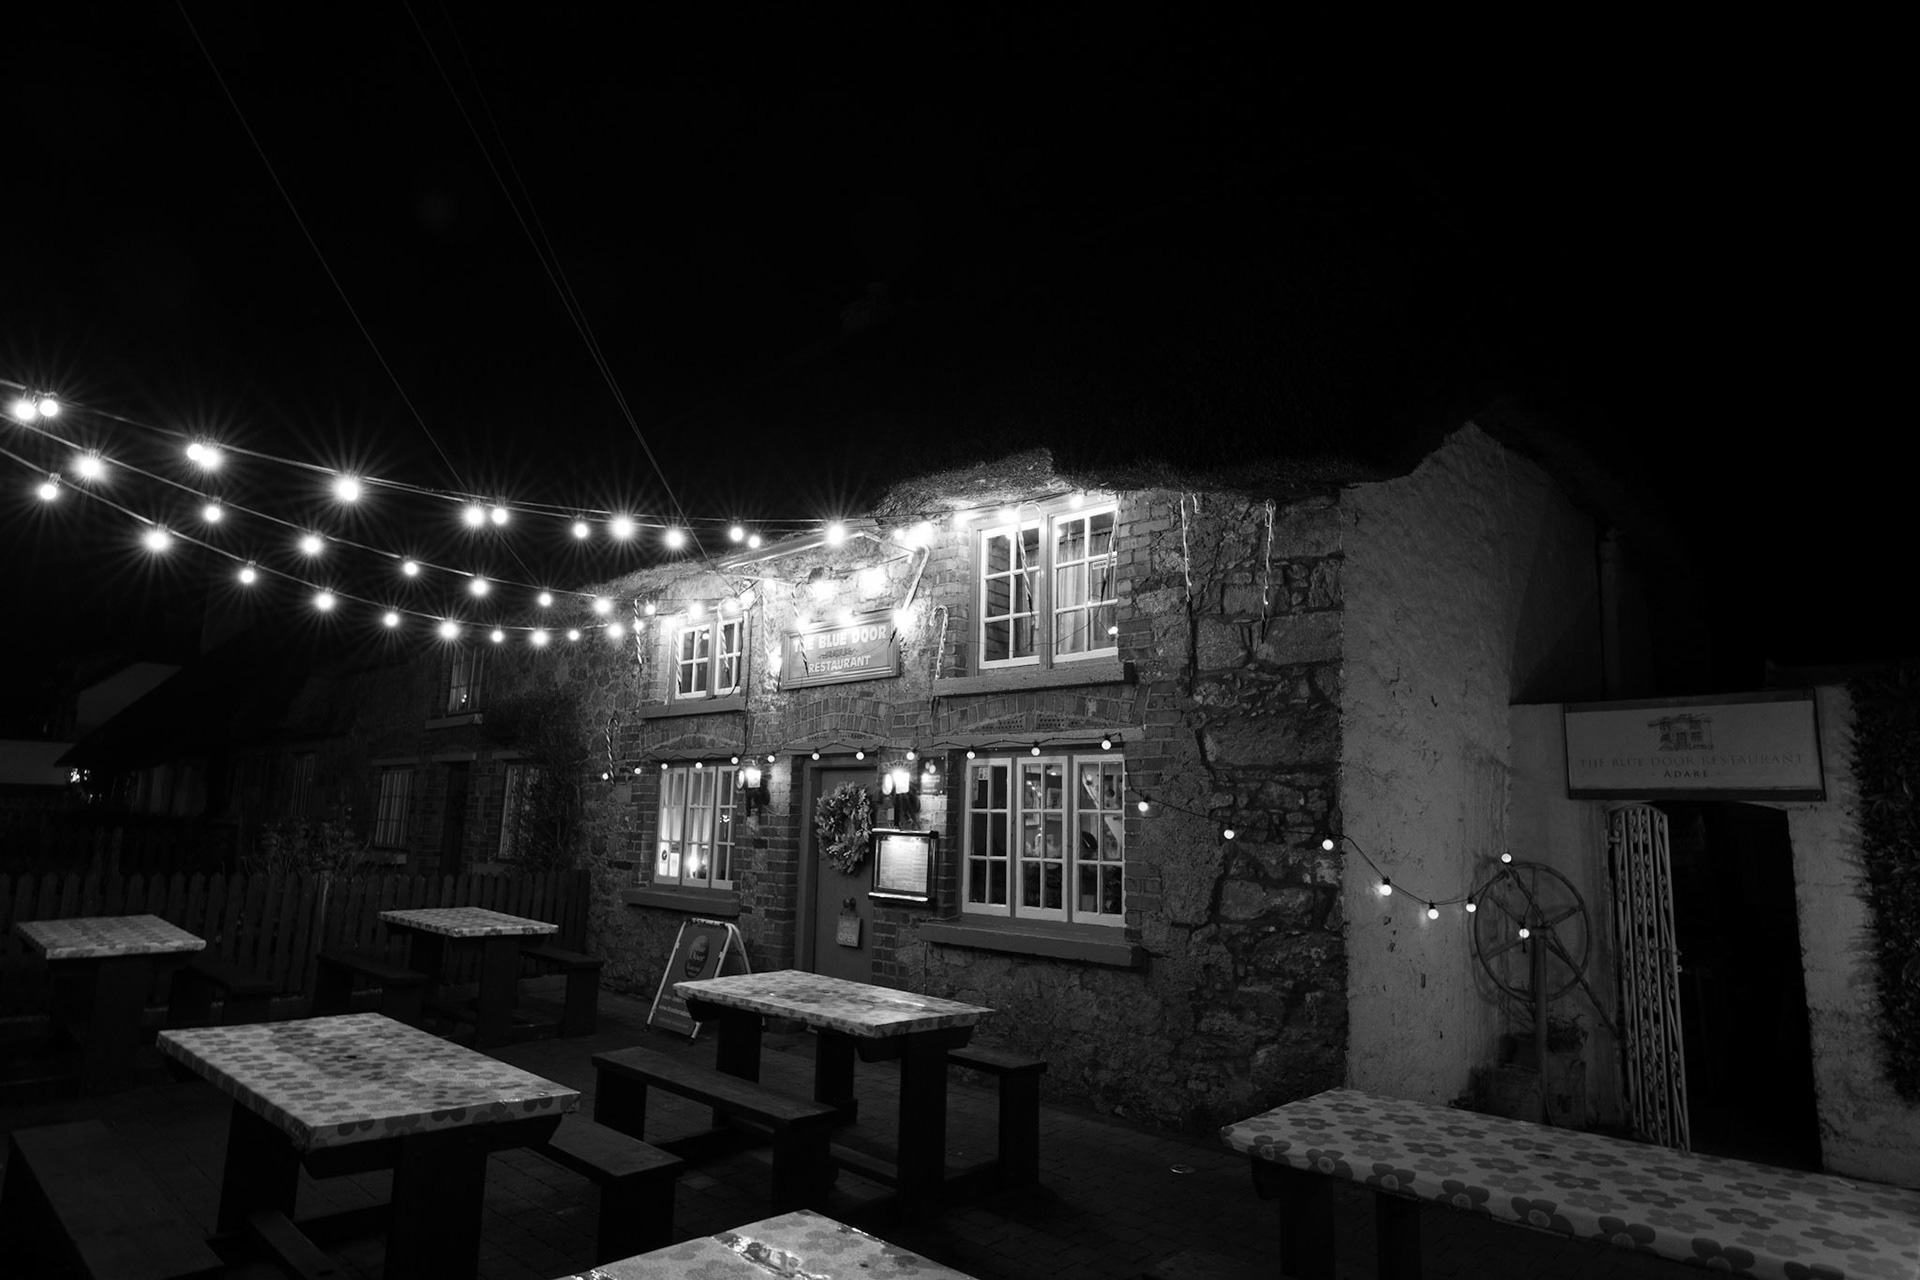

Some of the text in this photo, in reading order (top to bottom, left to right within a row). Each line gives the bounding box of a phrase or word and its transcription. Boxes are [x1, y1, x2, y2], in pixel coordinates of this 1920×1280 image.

[818, 632, 847, 649] BLUE
[851, 625, 887, 643] DOOR
[808, 655, 871, 673] RESTAURANT
[1579, 753, 1803, 768] THE BLUE DOOR RESTAURANT
[1663, 769, 1709, 779] ADARE
